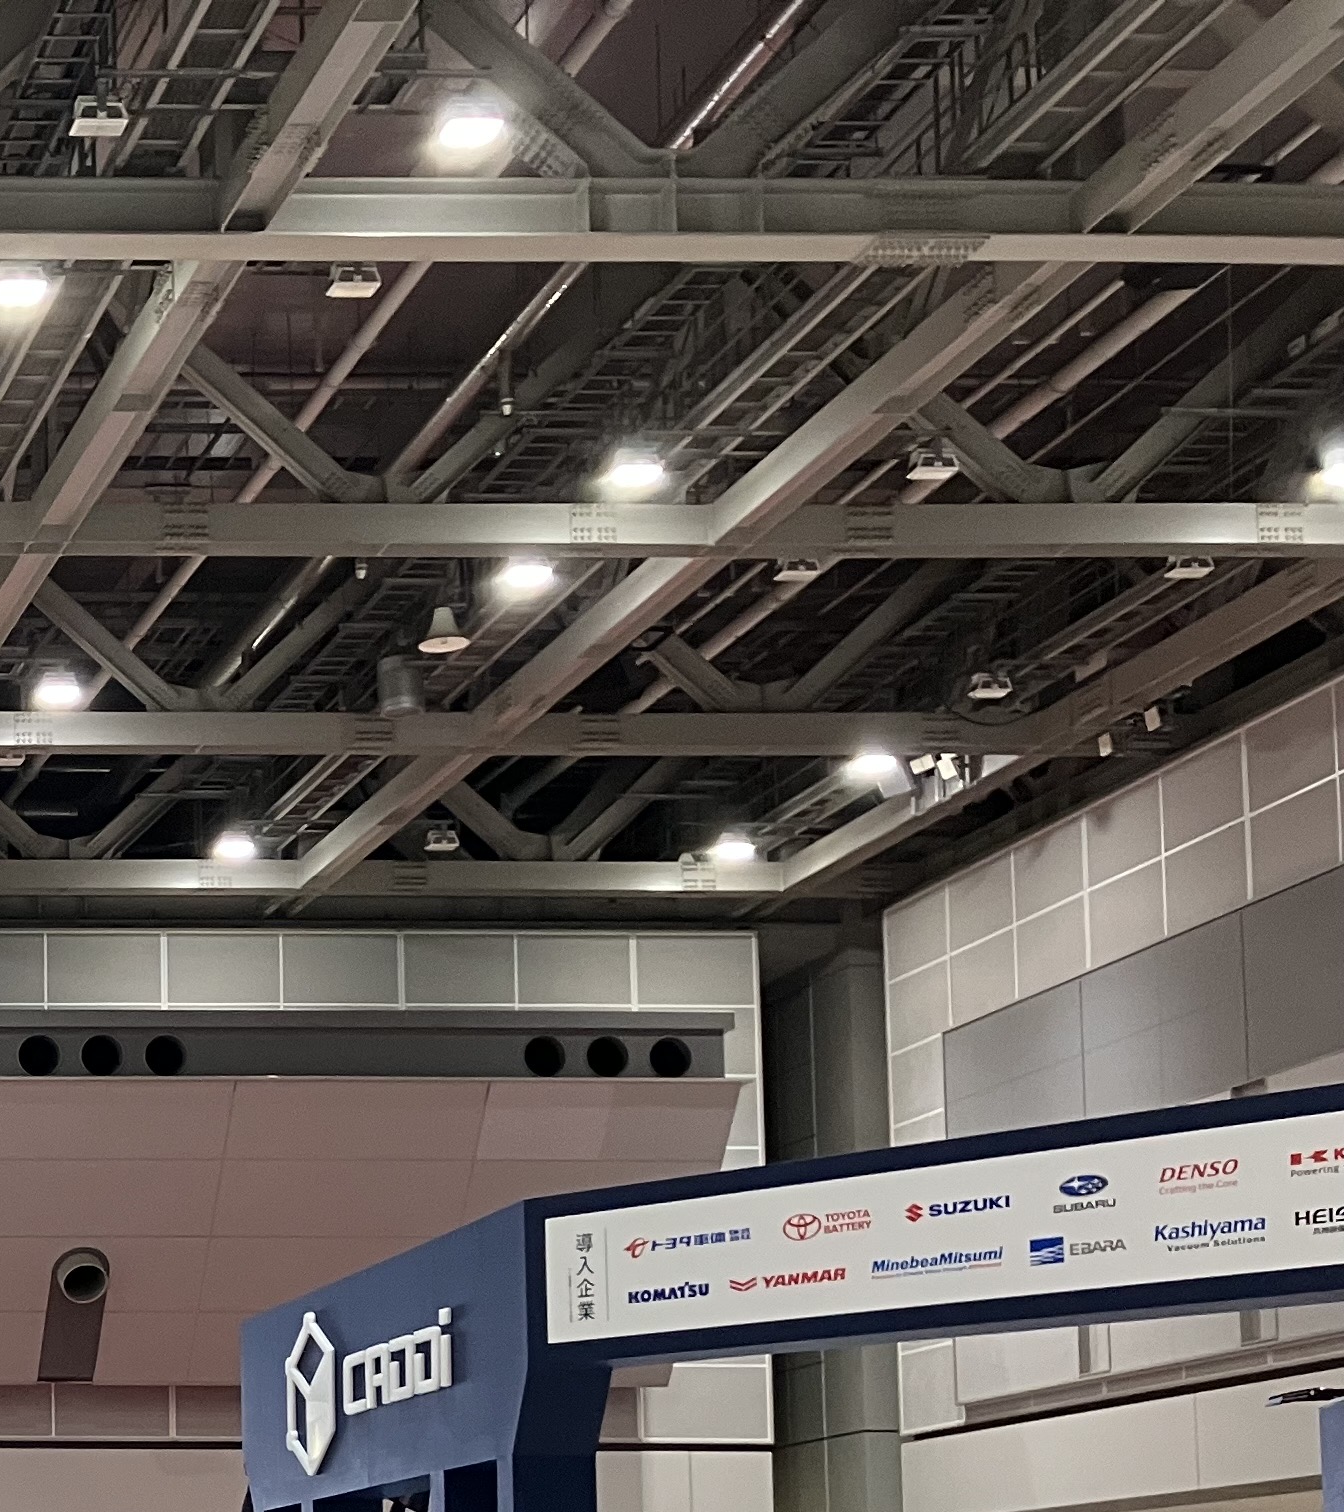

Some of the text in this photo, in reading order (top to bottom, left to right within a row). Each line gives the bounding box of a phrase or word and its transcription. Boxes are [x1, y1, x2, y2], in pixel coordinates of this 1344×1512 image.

[1159, 1158, 1238, 1183] DENSO
[1291, 1165, 1338, 1177] Powering
[825, 1209, 871, 1222] TOYOTA
[928, 1195, 1011, 1217] SUZUKI
[1053, 1199, 1117, 1214] SUBARU
[824, 1220, 872, 1234] BATTERY
[1154, 1217, 1266, 1241] Kashiyama
[1069, 1239, 1127, 1256] EBARA
[1167, 1236, 1266, 1252] Vacuum Solutions
[871, 1246, 1004, 1274] MinebeaMitsumi
[576, 1232, 596, 1322] 導入企業
[763, 1267, 847, 1289] YANMAR
[627, 1281, 710, 1304] KOMATSU
